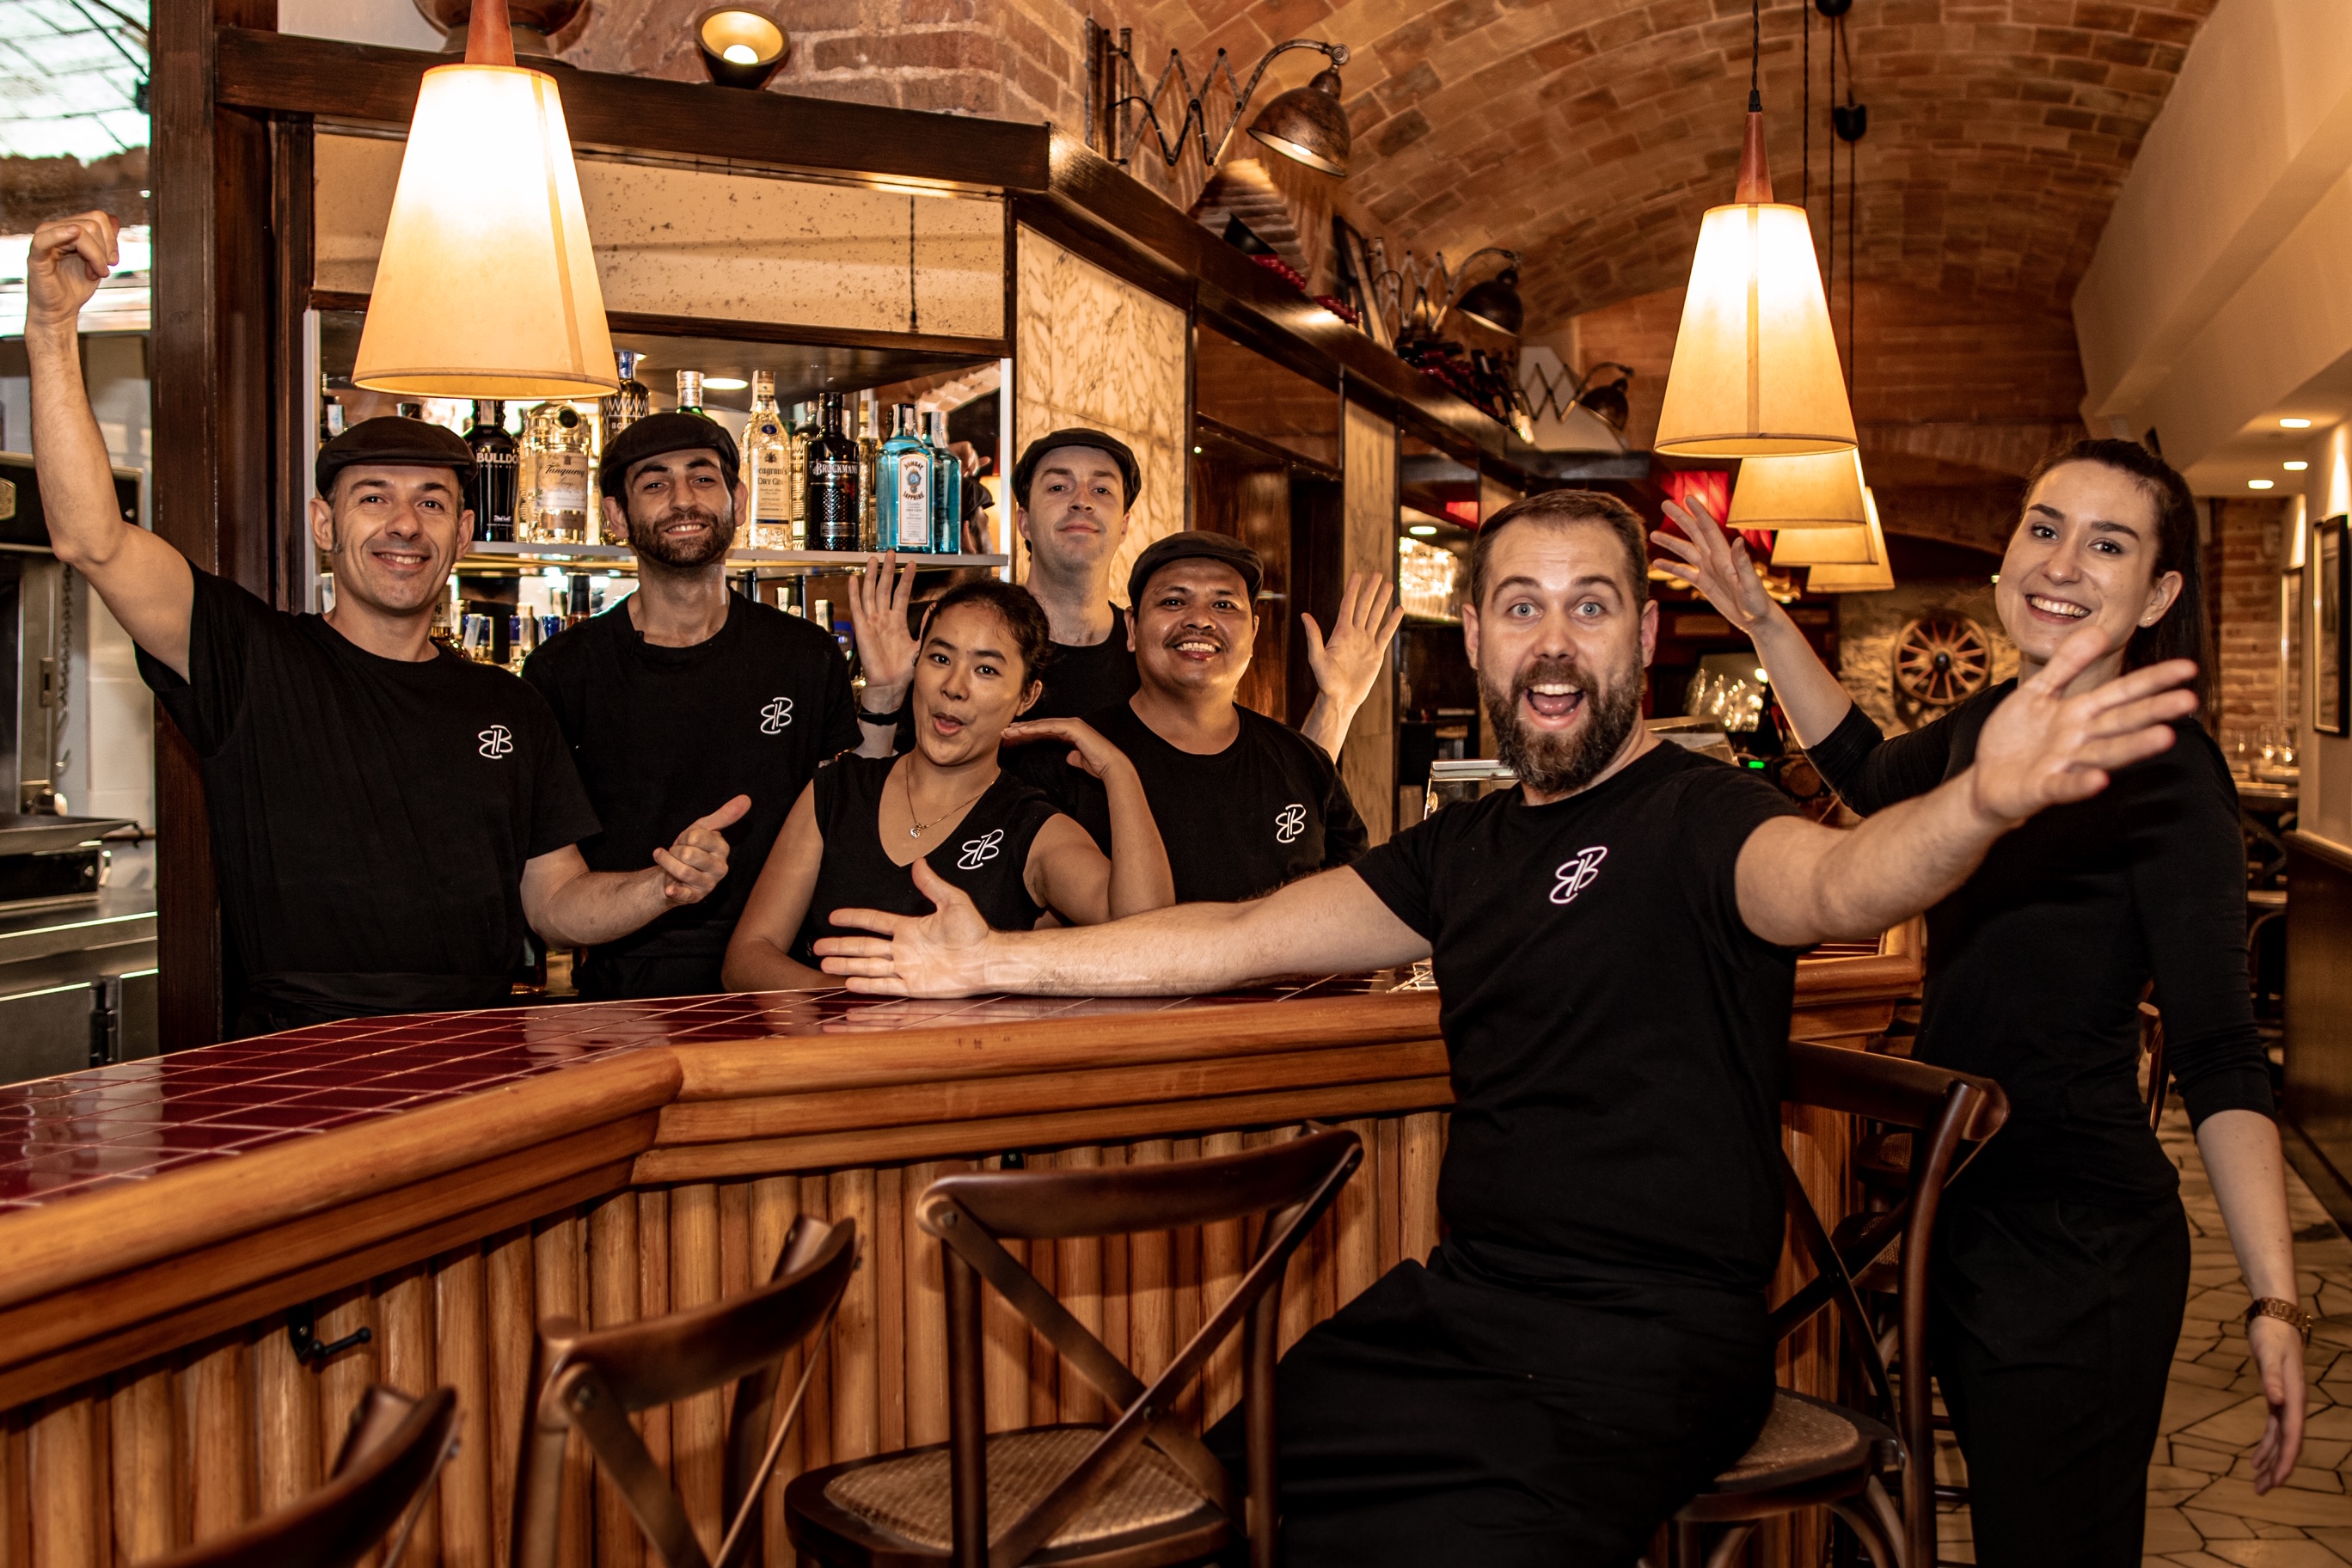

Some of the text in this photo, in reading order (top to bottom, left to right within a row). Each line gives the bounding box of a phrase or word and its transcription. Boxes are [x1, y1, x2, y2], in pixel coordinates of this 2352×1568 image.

[476, 452, 519, 464] BULLDO
[903, 460, 924, 470] BOMBAY
[545, 464, 585, 478] Tanqueray
[757, 476, 772, 486] DRY
[903, 491, 925, 500] SAPPHIRE
